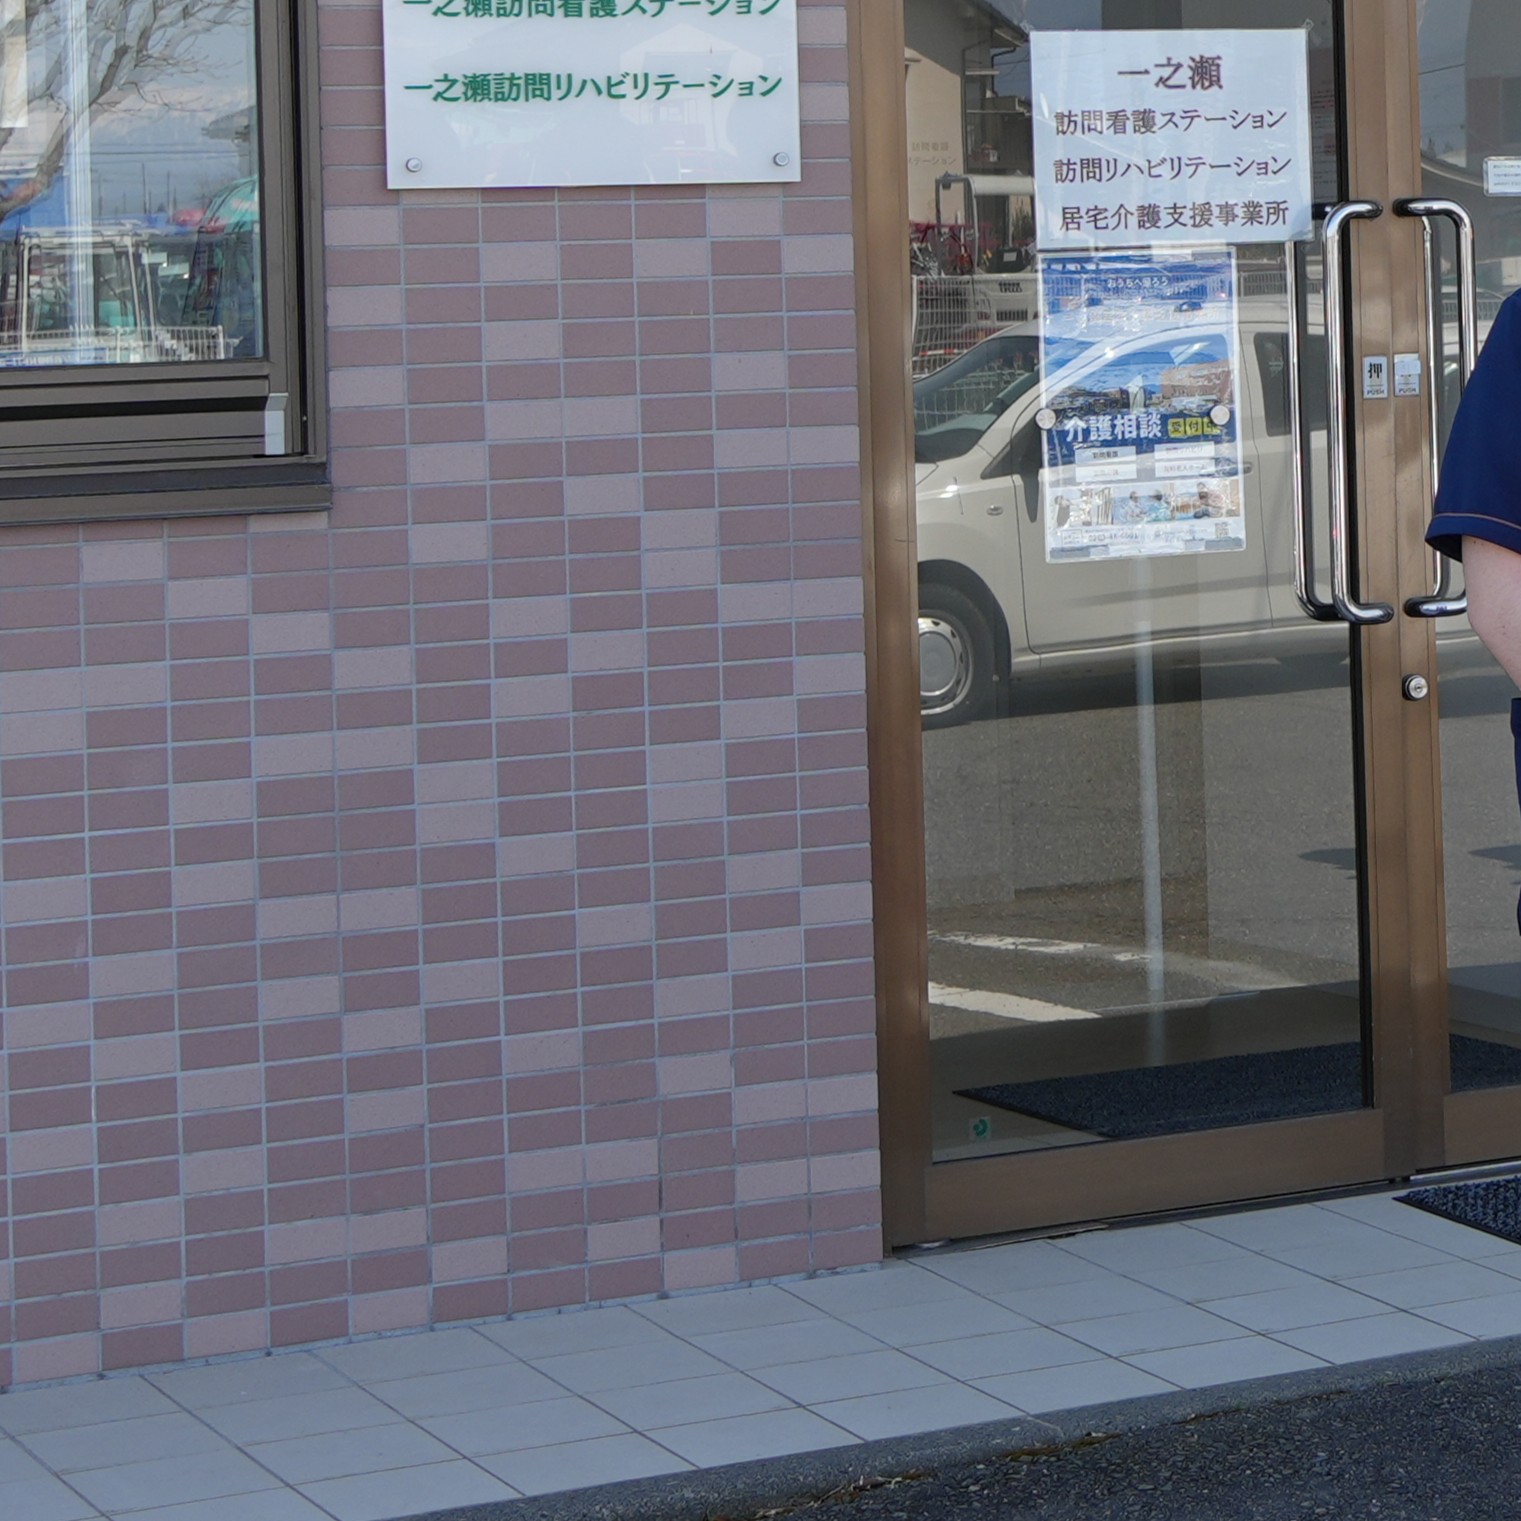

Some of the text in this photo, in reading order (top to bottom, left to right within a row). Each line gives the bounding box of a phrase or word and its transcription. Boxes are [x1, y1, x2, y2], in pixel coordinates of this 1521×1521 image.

[403, 72, 783, 103] 一之瀬訪問リハビリテーション
[1116, 54, 1224, 91] 一之瀬
[1053, 108, 1288, 136] 訪問看護ステーション
[1053, 156, 1292, 184] 訪問リハビリテーション
[1059, 199, 1290, 232] 居宅介護支援事業所
[1368, 362, 1382, 379] 押
[1064, 412, 1163, 443] 介護相談
